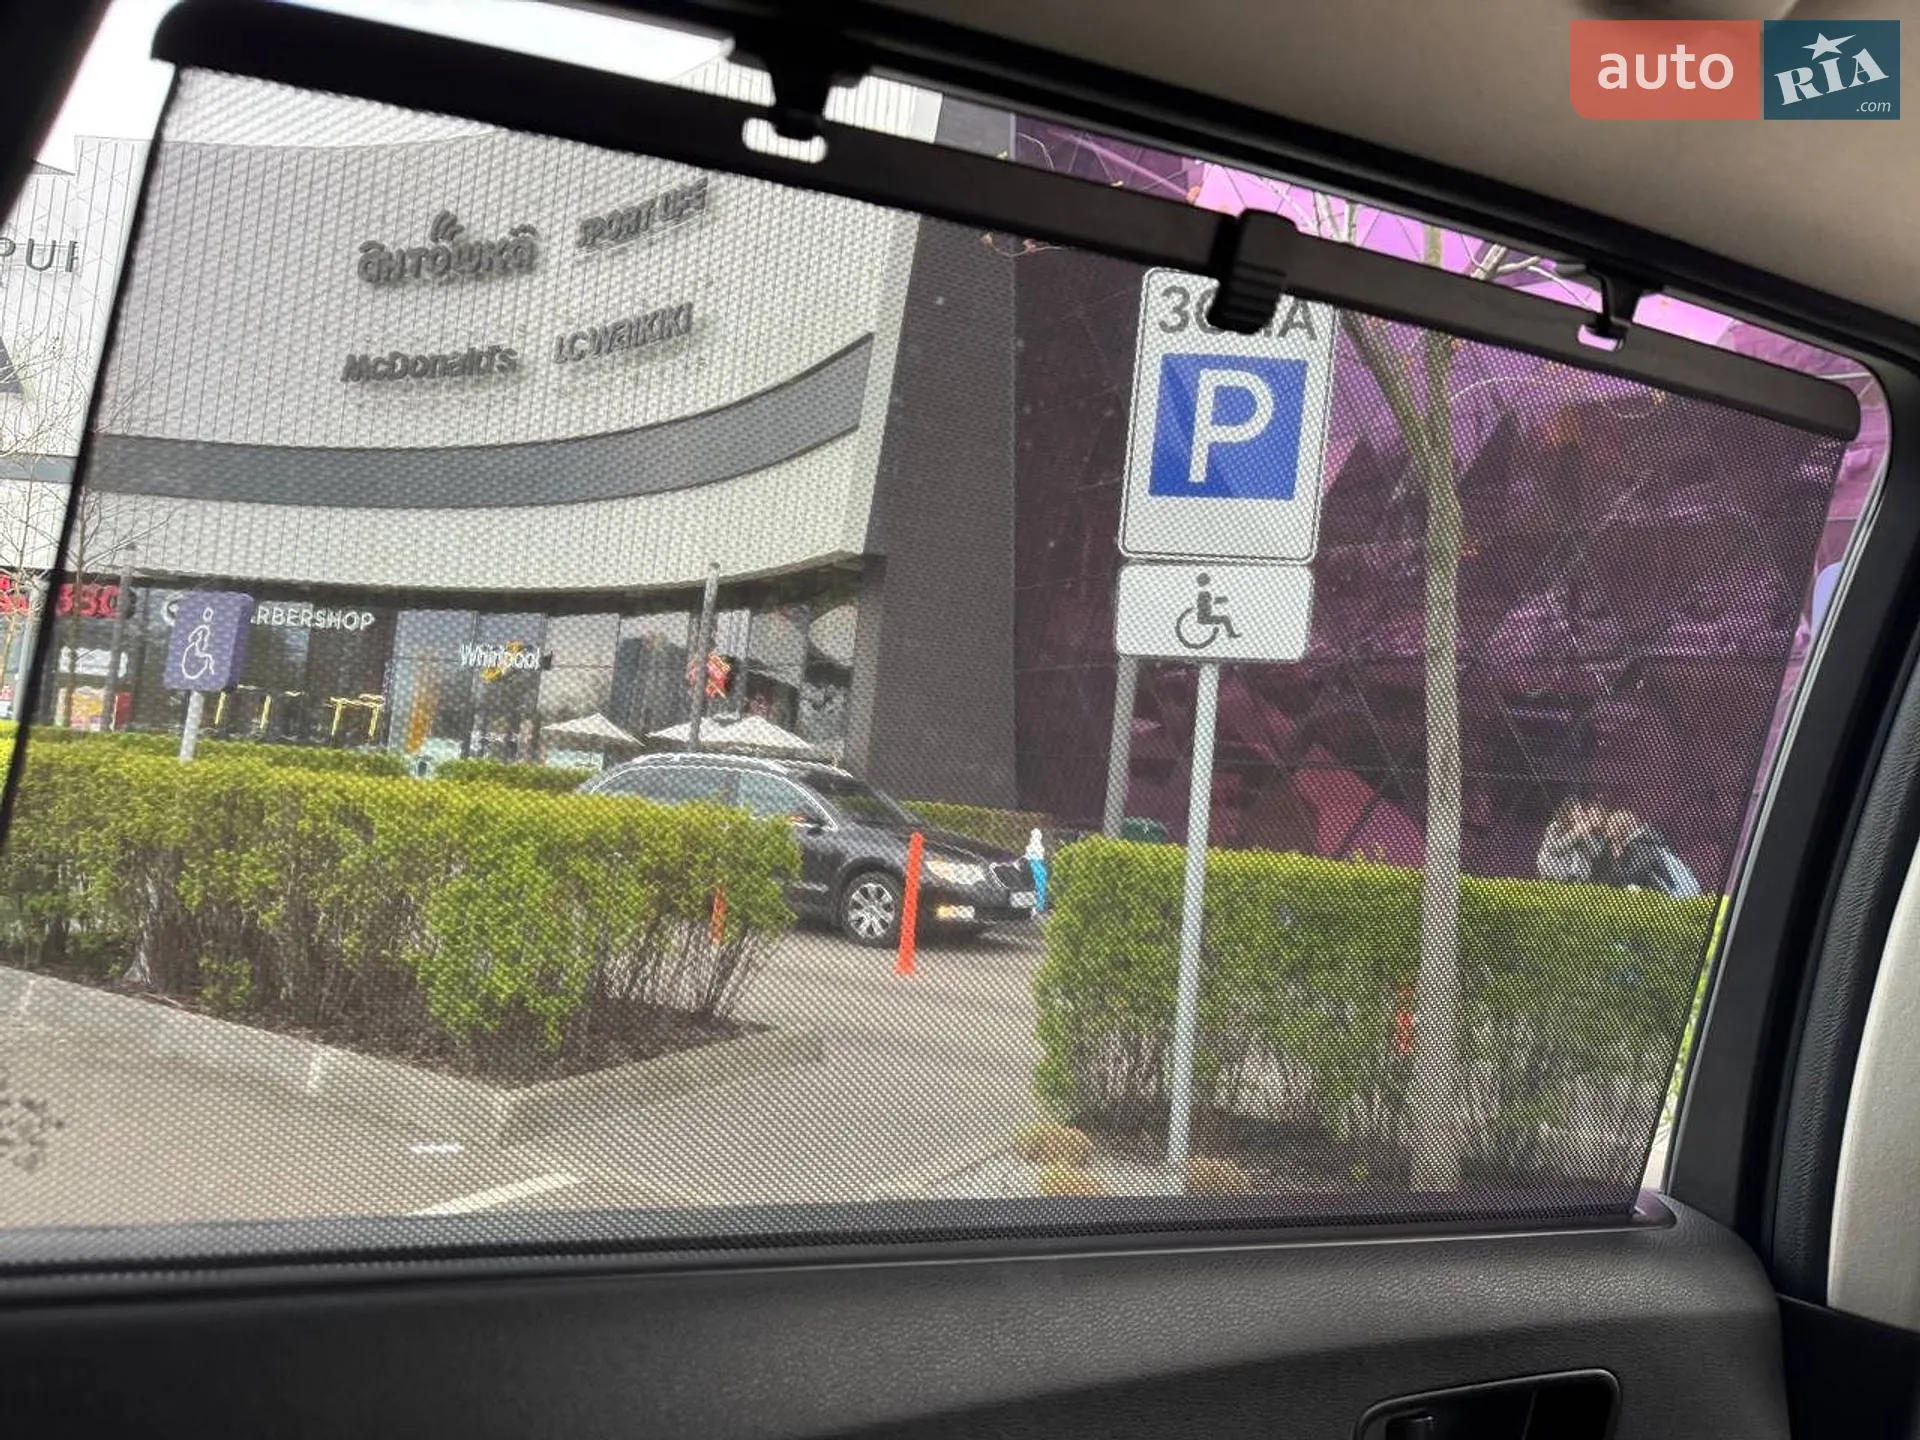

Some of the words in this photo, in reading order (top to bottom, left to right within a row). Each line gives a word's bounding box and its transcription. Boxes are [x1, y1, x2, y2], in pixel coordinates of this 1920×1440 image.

[1158, 285, 1318, 341] ЗОА
[1188, 368, 1276, 484] P
[250, 604, 376, 632] RBERSHOP
